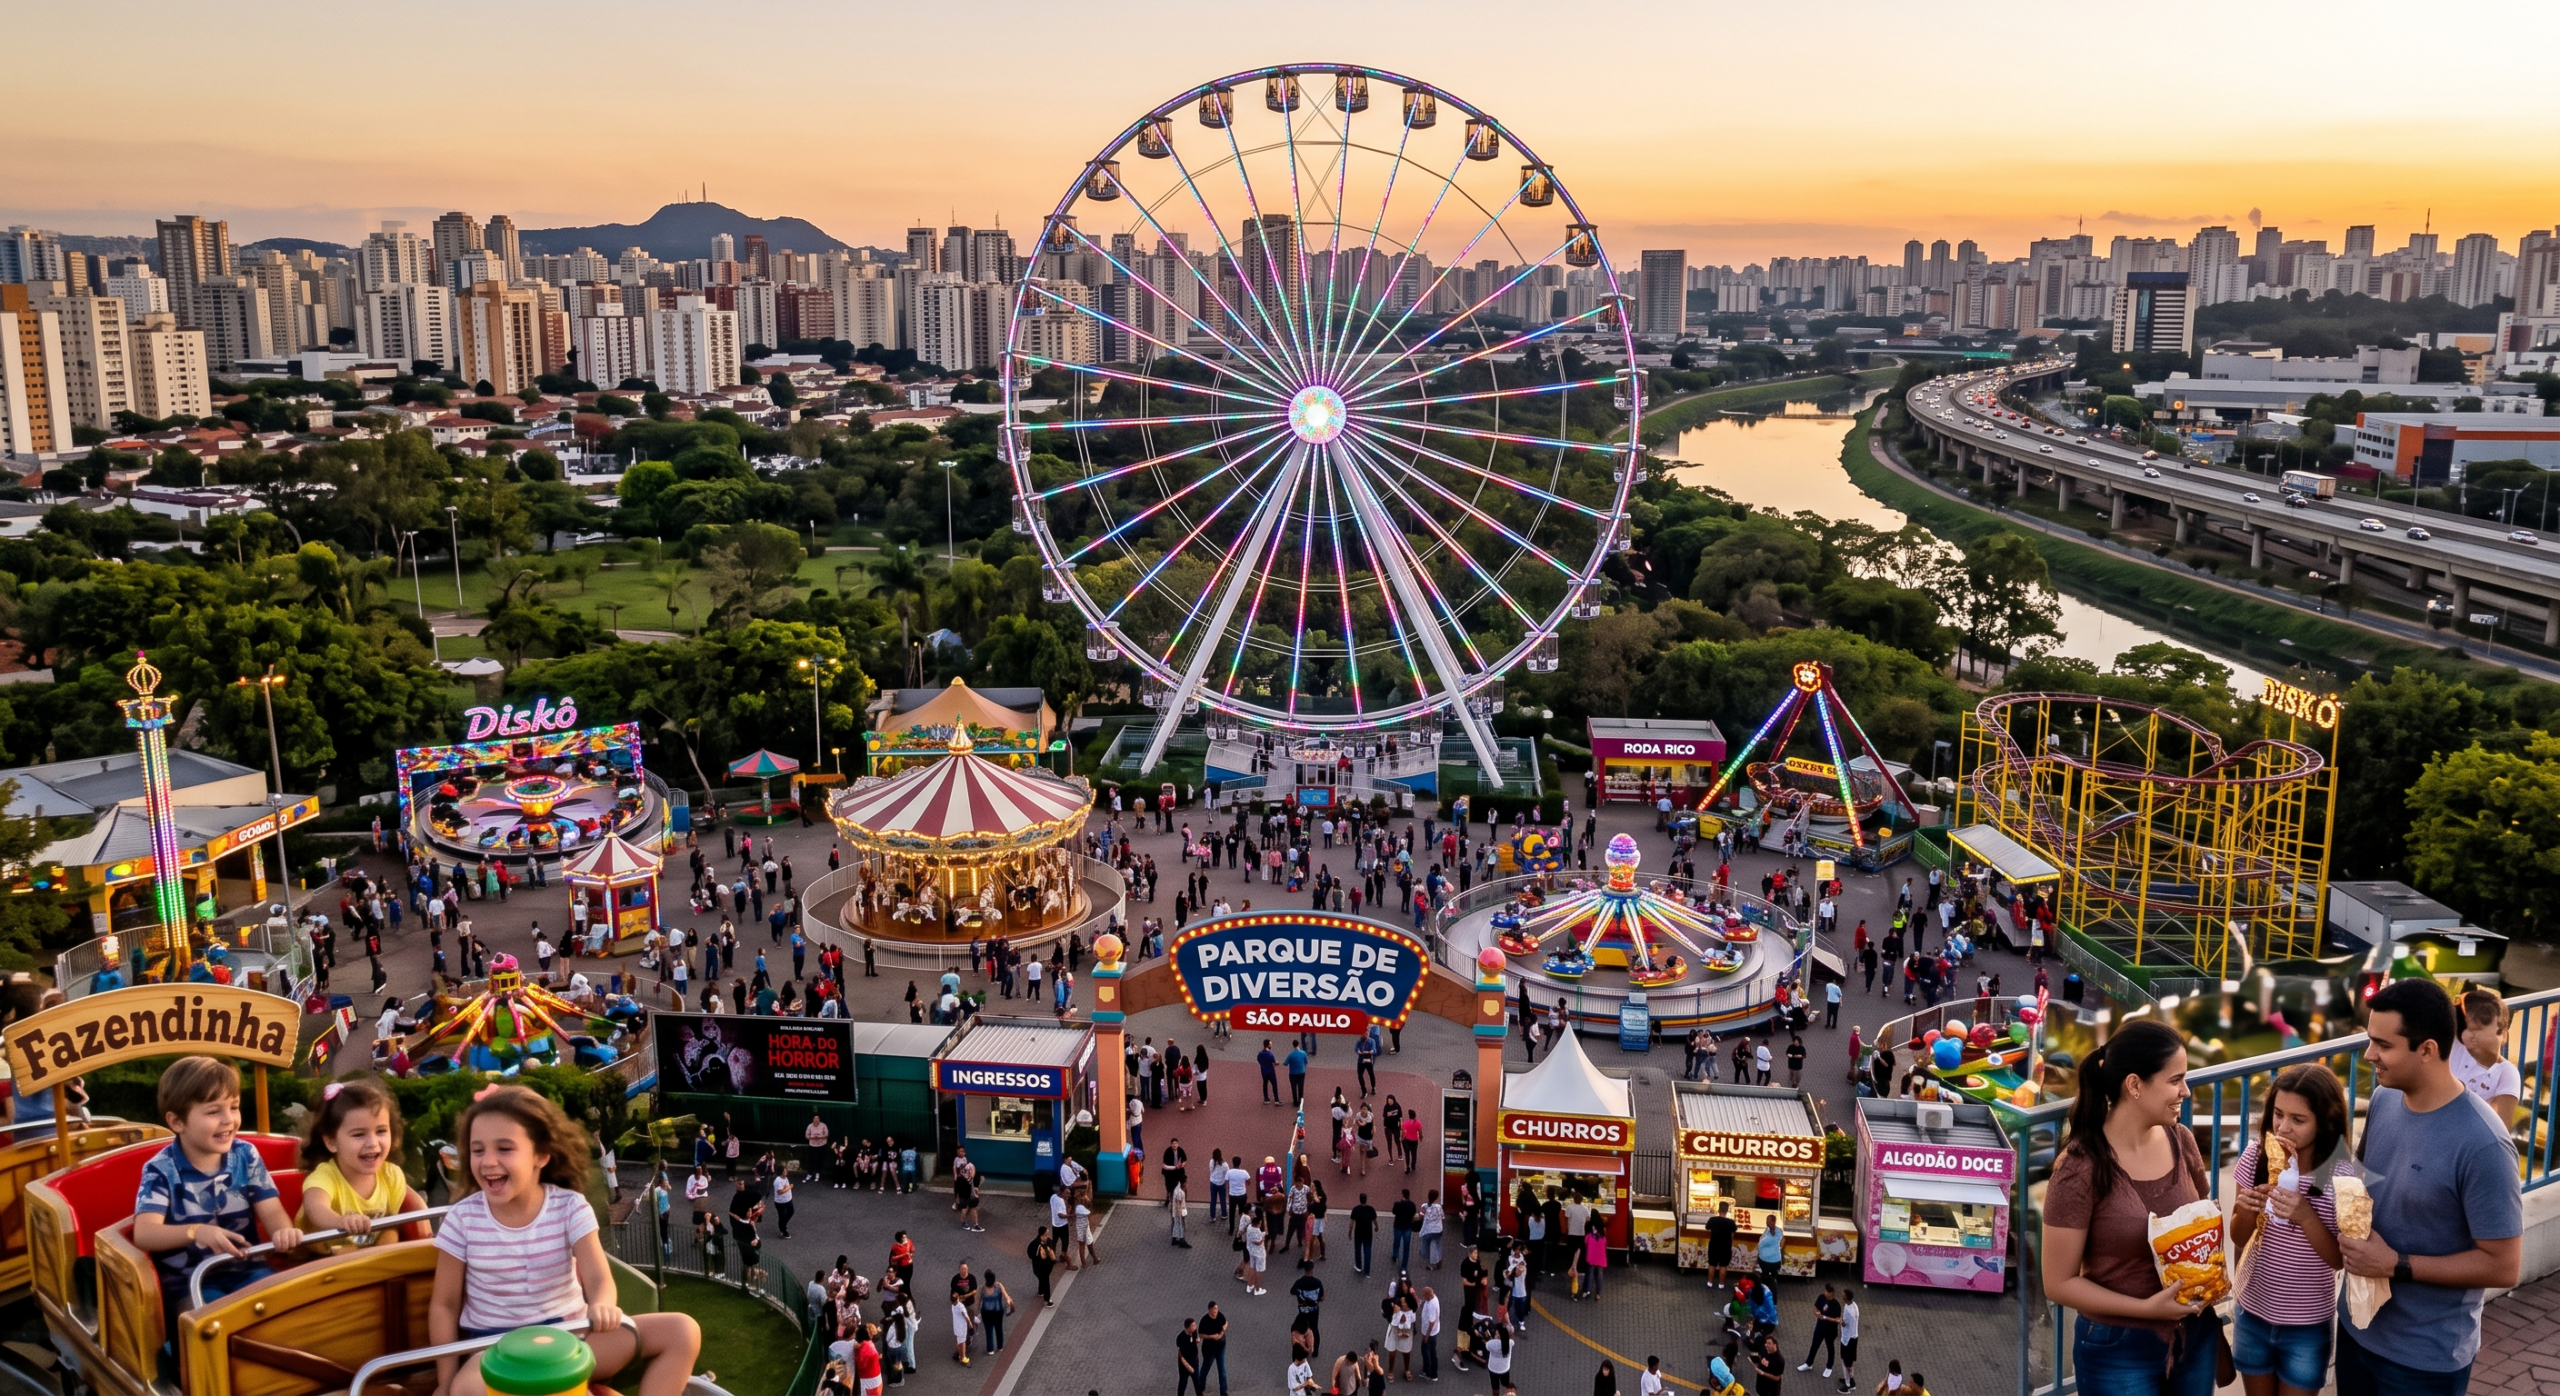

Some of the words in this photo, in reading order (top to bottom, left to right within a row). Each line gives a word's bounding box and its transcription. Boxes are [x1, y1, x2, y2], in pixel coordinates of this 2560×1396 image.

[464, 696, 577, 740] Diskô
[1624, 743, 1661, 754] RODA
[1664, 744, 1696, 755] RICO
[1197, 937, 1342, 969] PARQUE
[1351, 943, 1399, 974] DE
[1202, 969, 1395, 1007] DIVERSÃO
[1246, 1009, 1284, 1026] SÃO
[1288, 1012, 1351, 1029] PAULO
[14, 995, 286, 1081] Fazendinha
[768, 1034, 813, 1049] HORA
[817, 1037, 837, 1050] DO
[768, 1050, 840, 1069] HORROR
[952, 1070, 1051, 1088] INGRESSOS
[1512, 1119, 1620, 1142] CHURROS
[1692, 1135, 1813, 1159] CHURROS
[1882, 1150, 1957, 1169] ALGODÃO
[1961, 1156, 2004, 1173] DOCE
